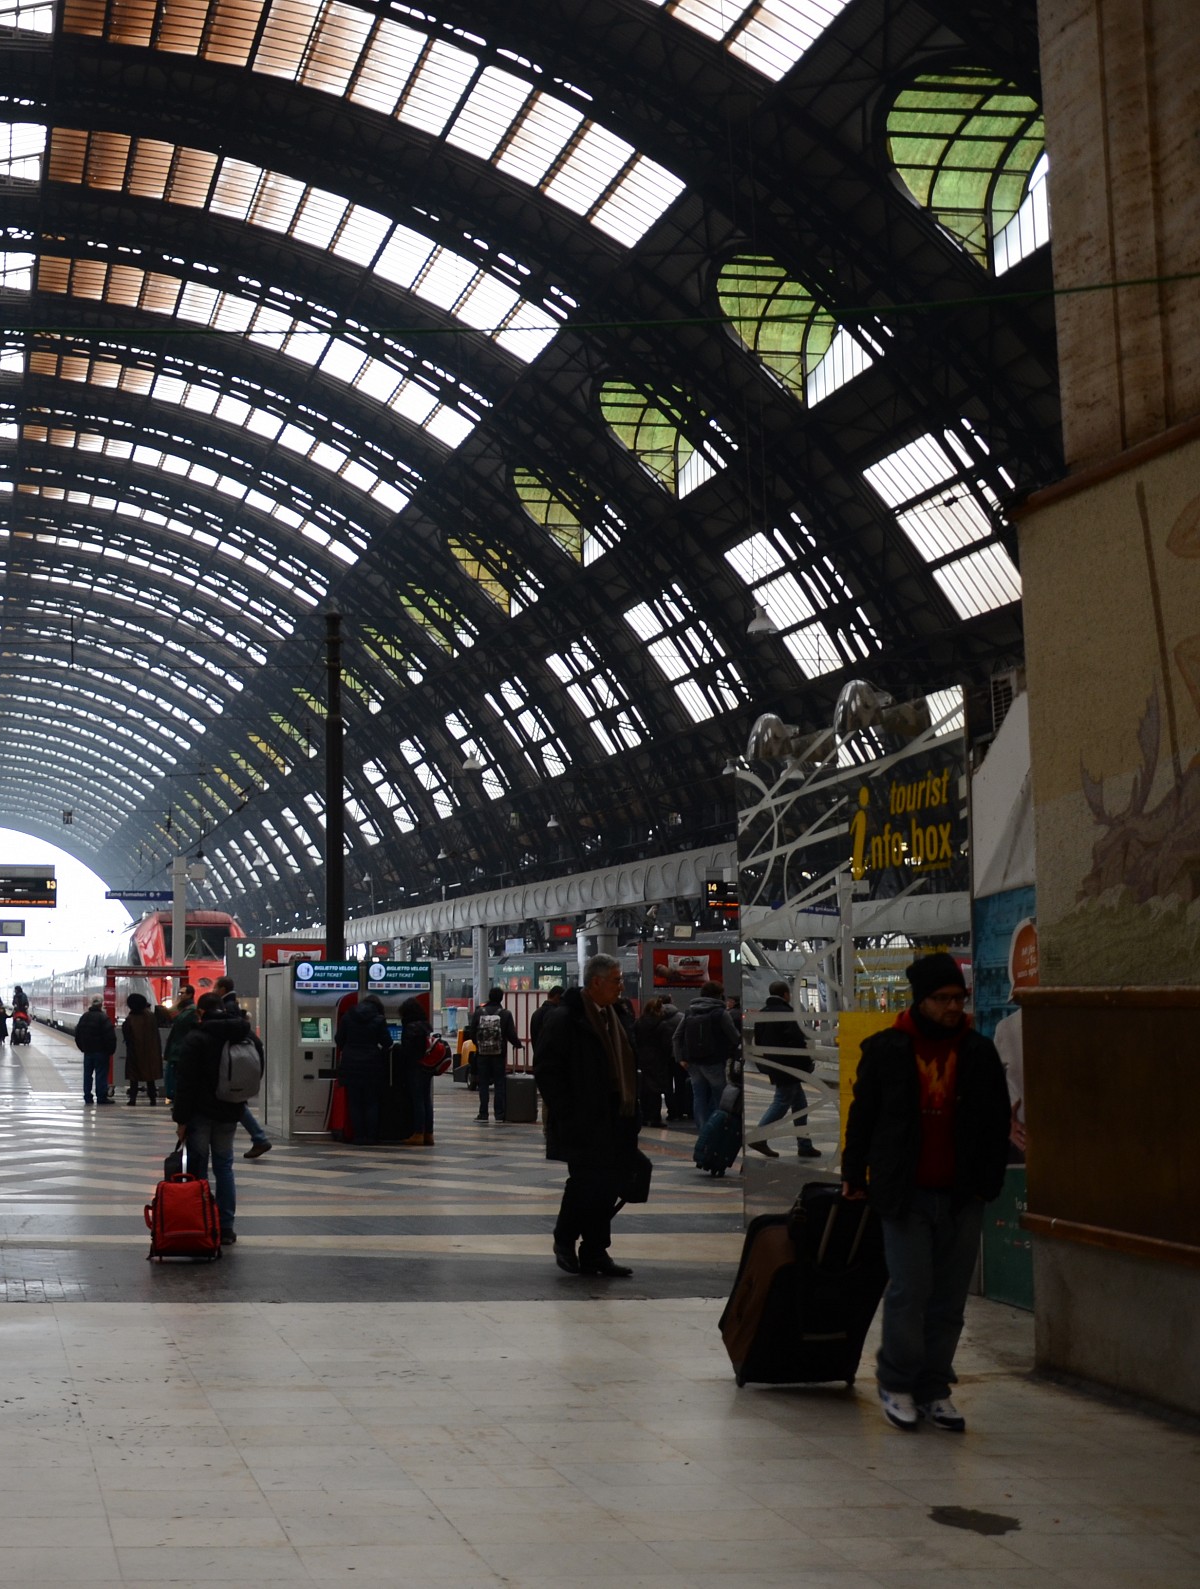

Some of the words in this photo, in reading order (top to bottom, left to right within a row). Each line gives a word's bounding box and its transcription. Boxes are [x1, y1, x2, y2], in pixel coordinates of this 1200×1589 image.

[890, 768, 949, 816] tourist
[911, 817, 952, 866] box
[46, 880, 57, 890] 13
[707, 883, 718, 892] 14
[236, 943, 256, 958] 13
